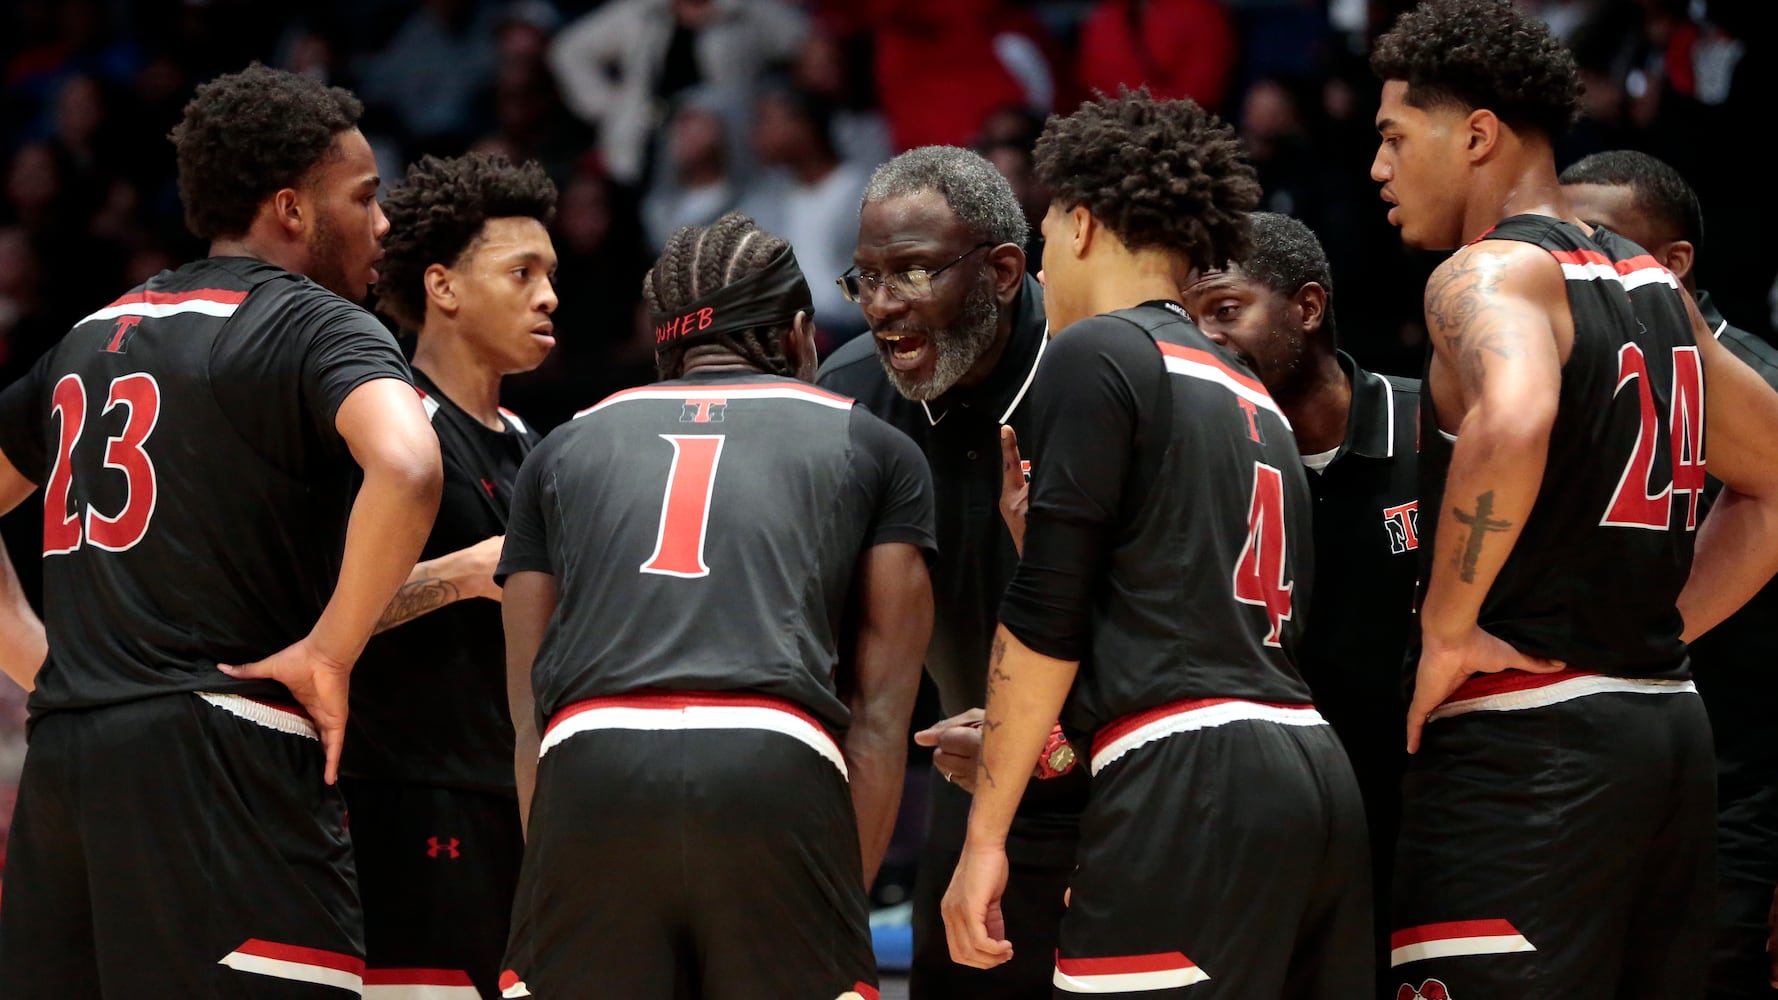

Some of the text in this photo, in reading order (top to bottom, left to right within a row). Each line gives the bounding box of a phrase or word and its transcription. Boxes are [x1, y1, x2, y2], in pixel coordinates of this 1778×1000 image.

[656, 307, 714, 344] WHEB
[43, 372, 160, 558] 23
[640, 434, 726, 578] 1
[1599, 341, 1706, 531] 24
[1234, 461, 1293, 648] 4
